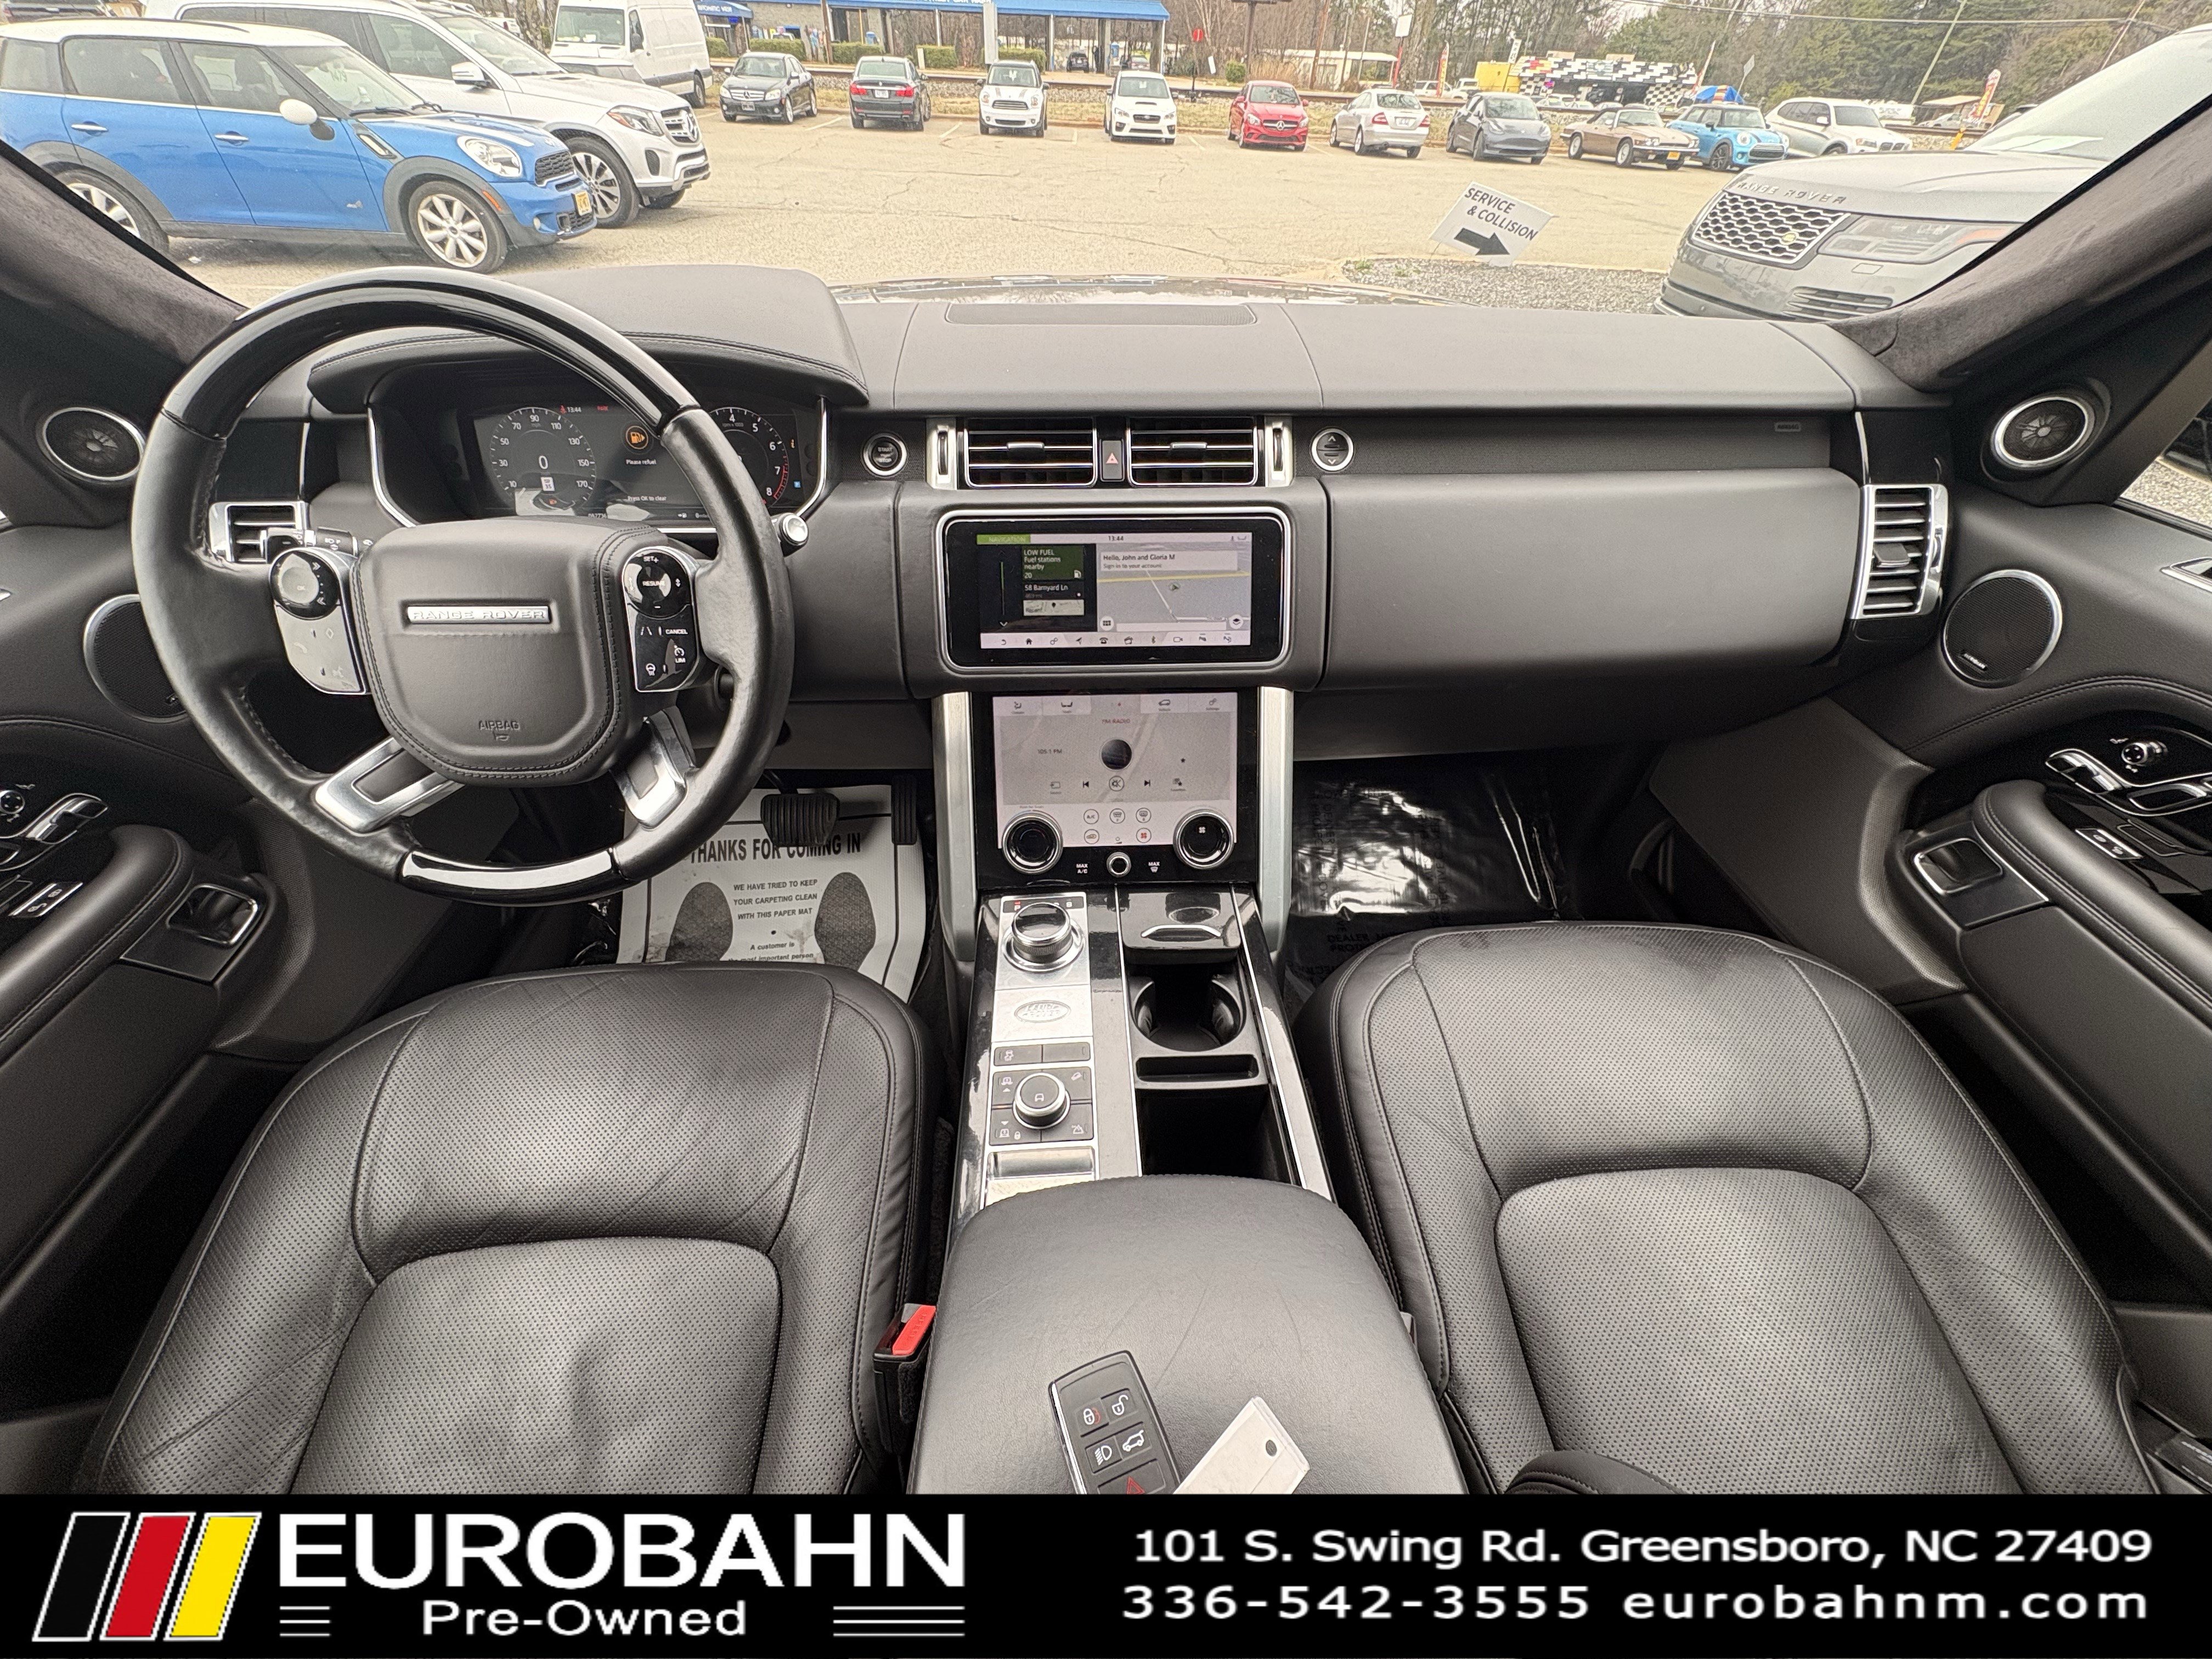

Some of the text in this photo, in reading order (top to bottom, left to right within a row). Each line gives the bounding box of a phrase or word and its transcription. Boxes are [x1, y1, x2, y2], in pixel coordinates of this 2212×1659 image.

[1736, 181, 1847, 205] RANGE ROVER
[1464, 188, 1515, 214] SERVICE
[1467, 205, 1539, 241] & COLLISION
[729, 414, 736, 422] 4
[551, 422, 562, 430] 110
[752, 423, 758, 432] 5
[568, 437, 581, 445] 130
[769, 441, 776, 451] 6
[539, 455, 549, 470] 0
[775, 466, 781, 475] 7
[766, 487, 772, 496] 8
[1034, 584, 1060, 592] Barnyard
[414, 611, 545, 619] RANGE ROVER
[478, 720, 521, 731] AIRBAG
[753, 838, 781, 860] FOR
[847, 832, 861, 854] IN
[755, 895, 793, 905] CARPETING
[774, 909, 797, 917] PAPER
[798, 907, 813, 916] MAT
[757, 941, 788, 950] customer
